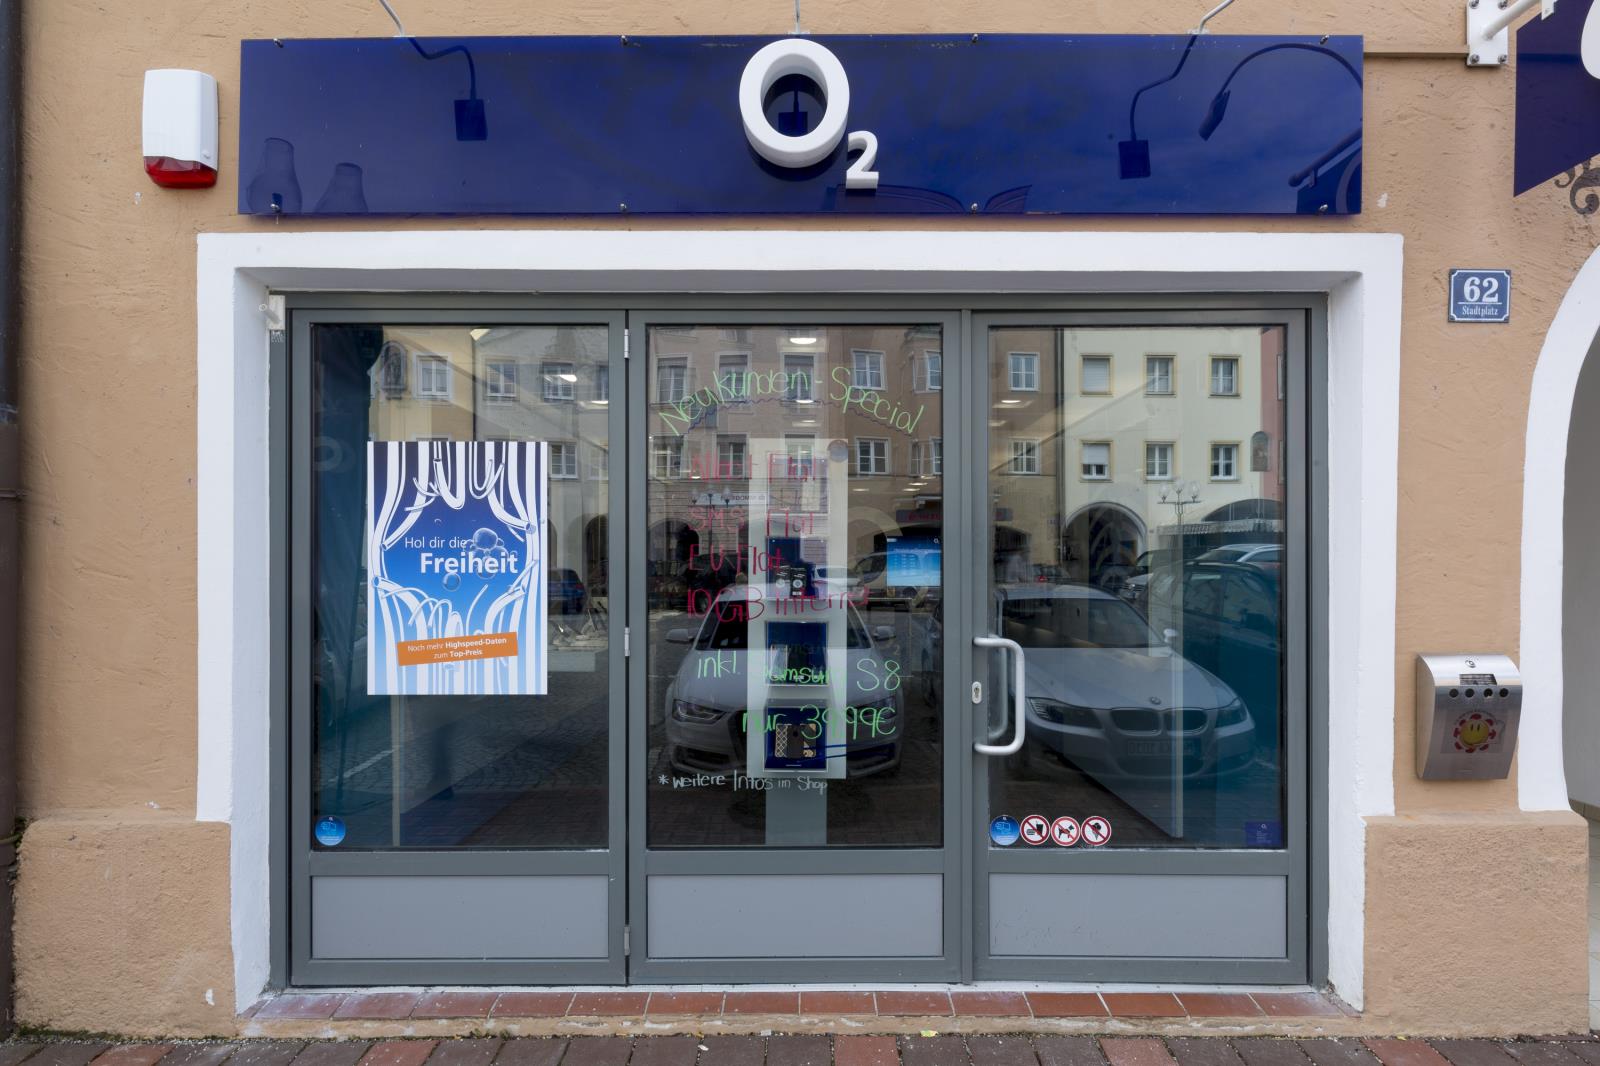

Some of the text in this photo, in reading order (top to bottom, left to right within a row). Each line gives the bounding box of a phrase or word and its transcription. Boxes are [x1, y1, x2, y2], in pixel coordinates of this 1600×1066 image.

[1463, 276, 1499, 303] 62
[1462, 305, 1498, 316] Stadtplatz
[689, 450, 752, 481] Allnt
[688, 507, 745, 533] SMS
[404, 536, 467, 549] Hol dir die
[420, 552, 519, 575] Freiheit
[689, 544, 784, 574] EU Flat
[407, 637, 507, 654] Noch mehr Highspeed-Daten
[433, 649, 483, 662] zum Top-Preis
[856, 658, 902, 692] S8
[797, 775, 829, 796] Shop
